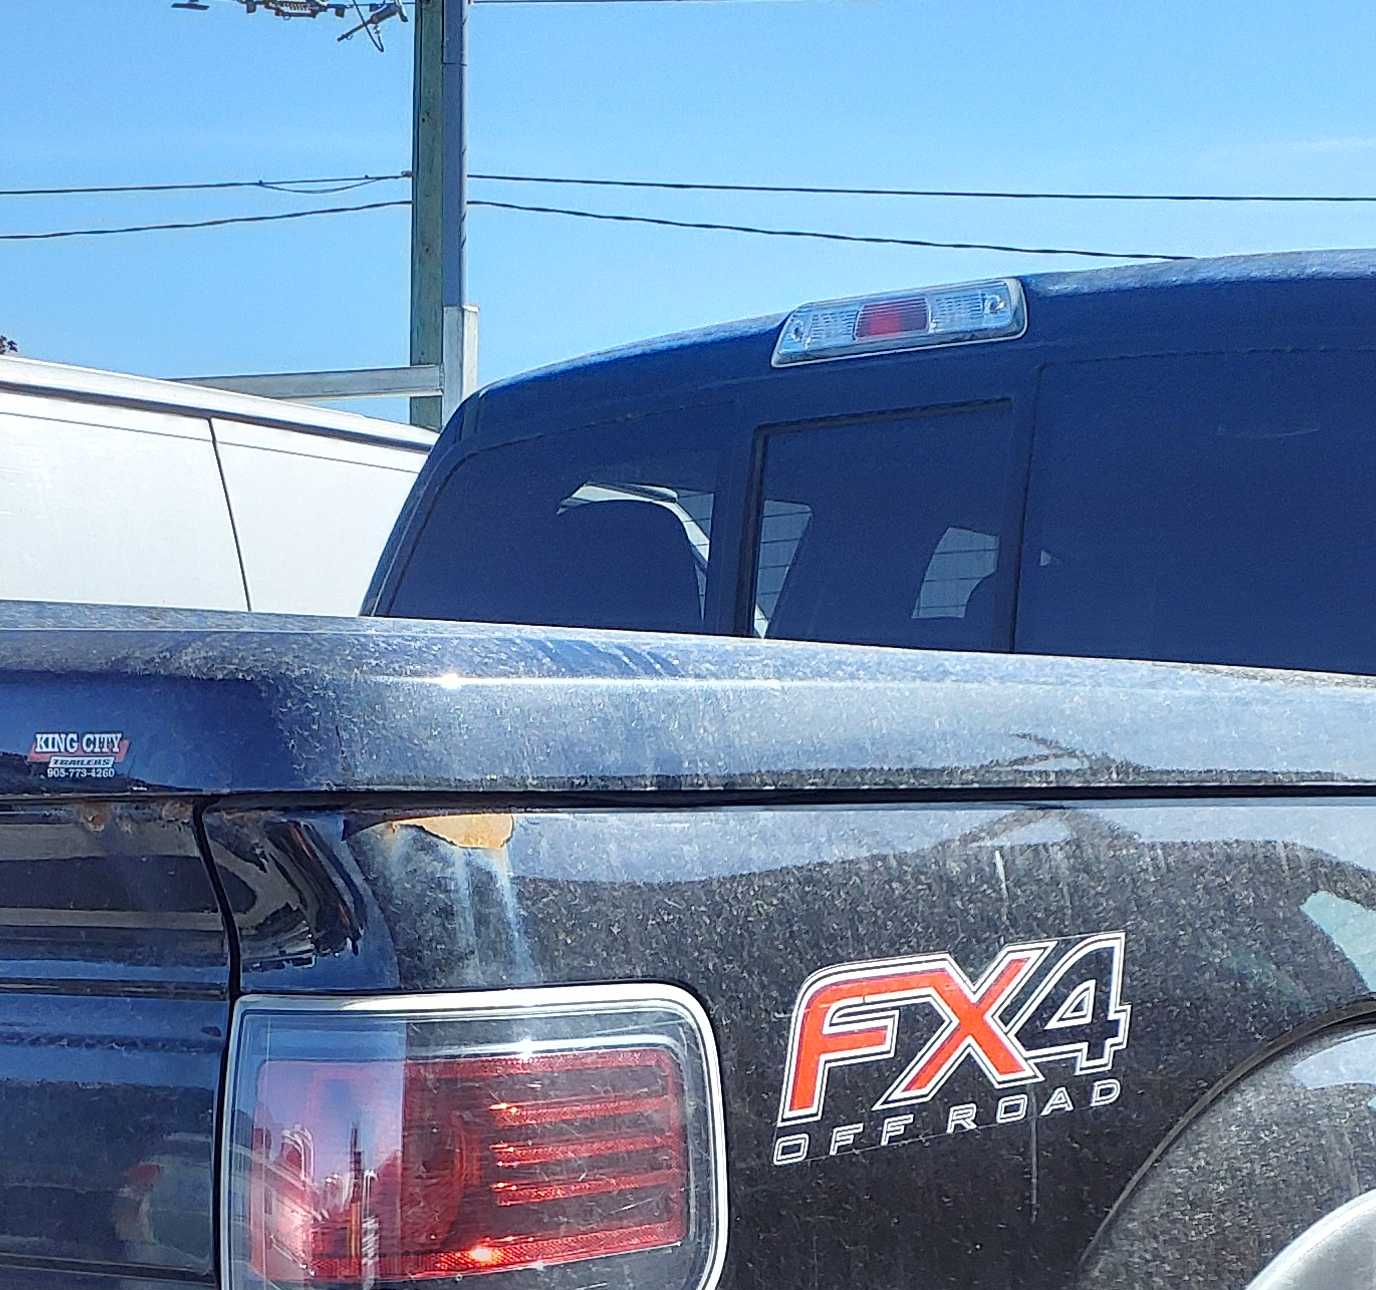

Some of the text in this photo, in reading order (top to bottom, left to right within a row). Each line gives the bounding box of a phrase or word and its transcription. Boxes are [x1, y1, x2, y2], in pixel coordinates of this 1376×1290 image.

[35, 732, 123, 753] KING CITY
[776, 931, 1132, 1127] FX4
[773, 1079, 1122, 1167] OFF ROAD
